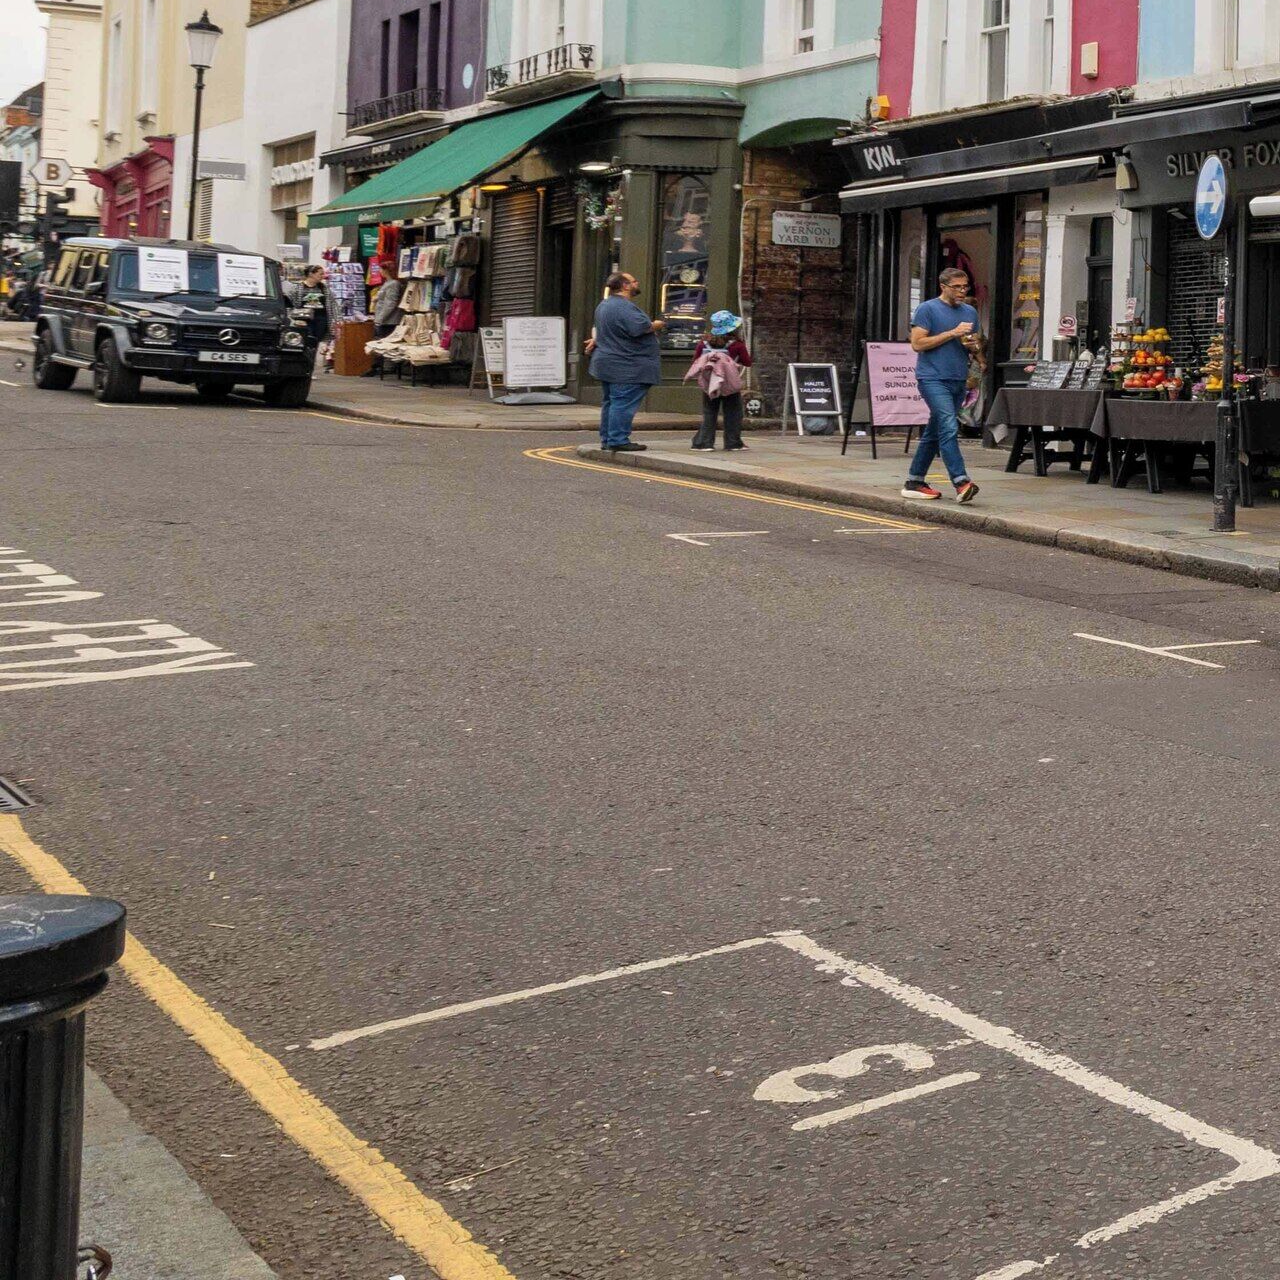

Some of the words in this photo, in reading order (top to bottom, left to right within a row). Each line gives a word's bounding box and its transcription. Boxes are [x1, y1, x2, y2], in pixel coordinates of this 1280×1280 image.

[863, 144, 902, 172] KIN.
[1166, 148, 1233, 178] SILVR
[46, 163, 60, 181] B
[783, 225, 831, 236] VERNON
[778, 234, 809, 244] YARD
[211, 352, 225, 361] C4
[227, 353, 248, 362] SES
